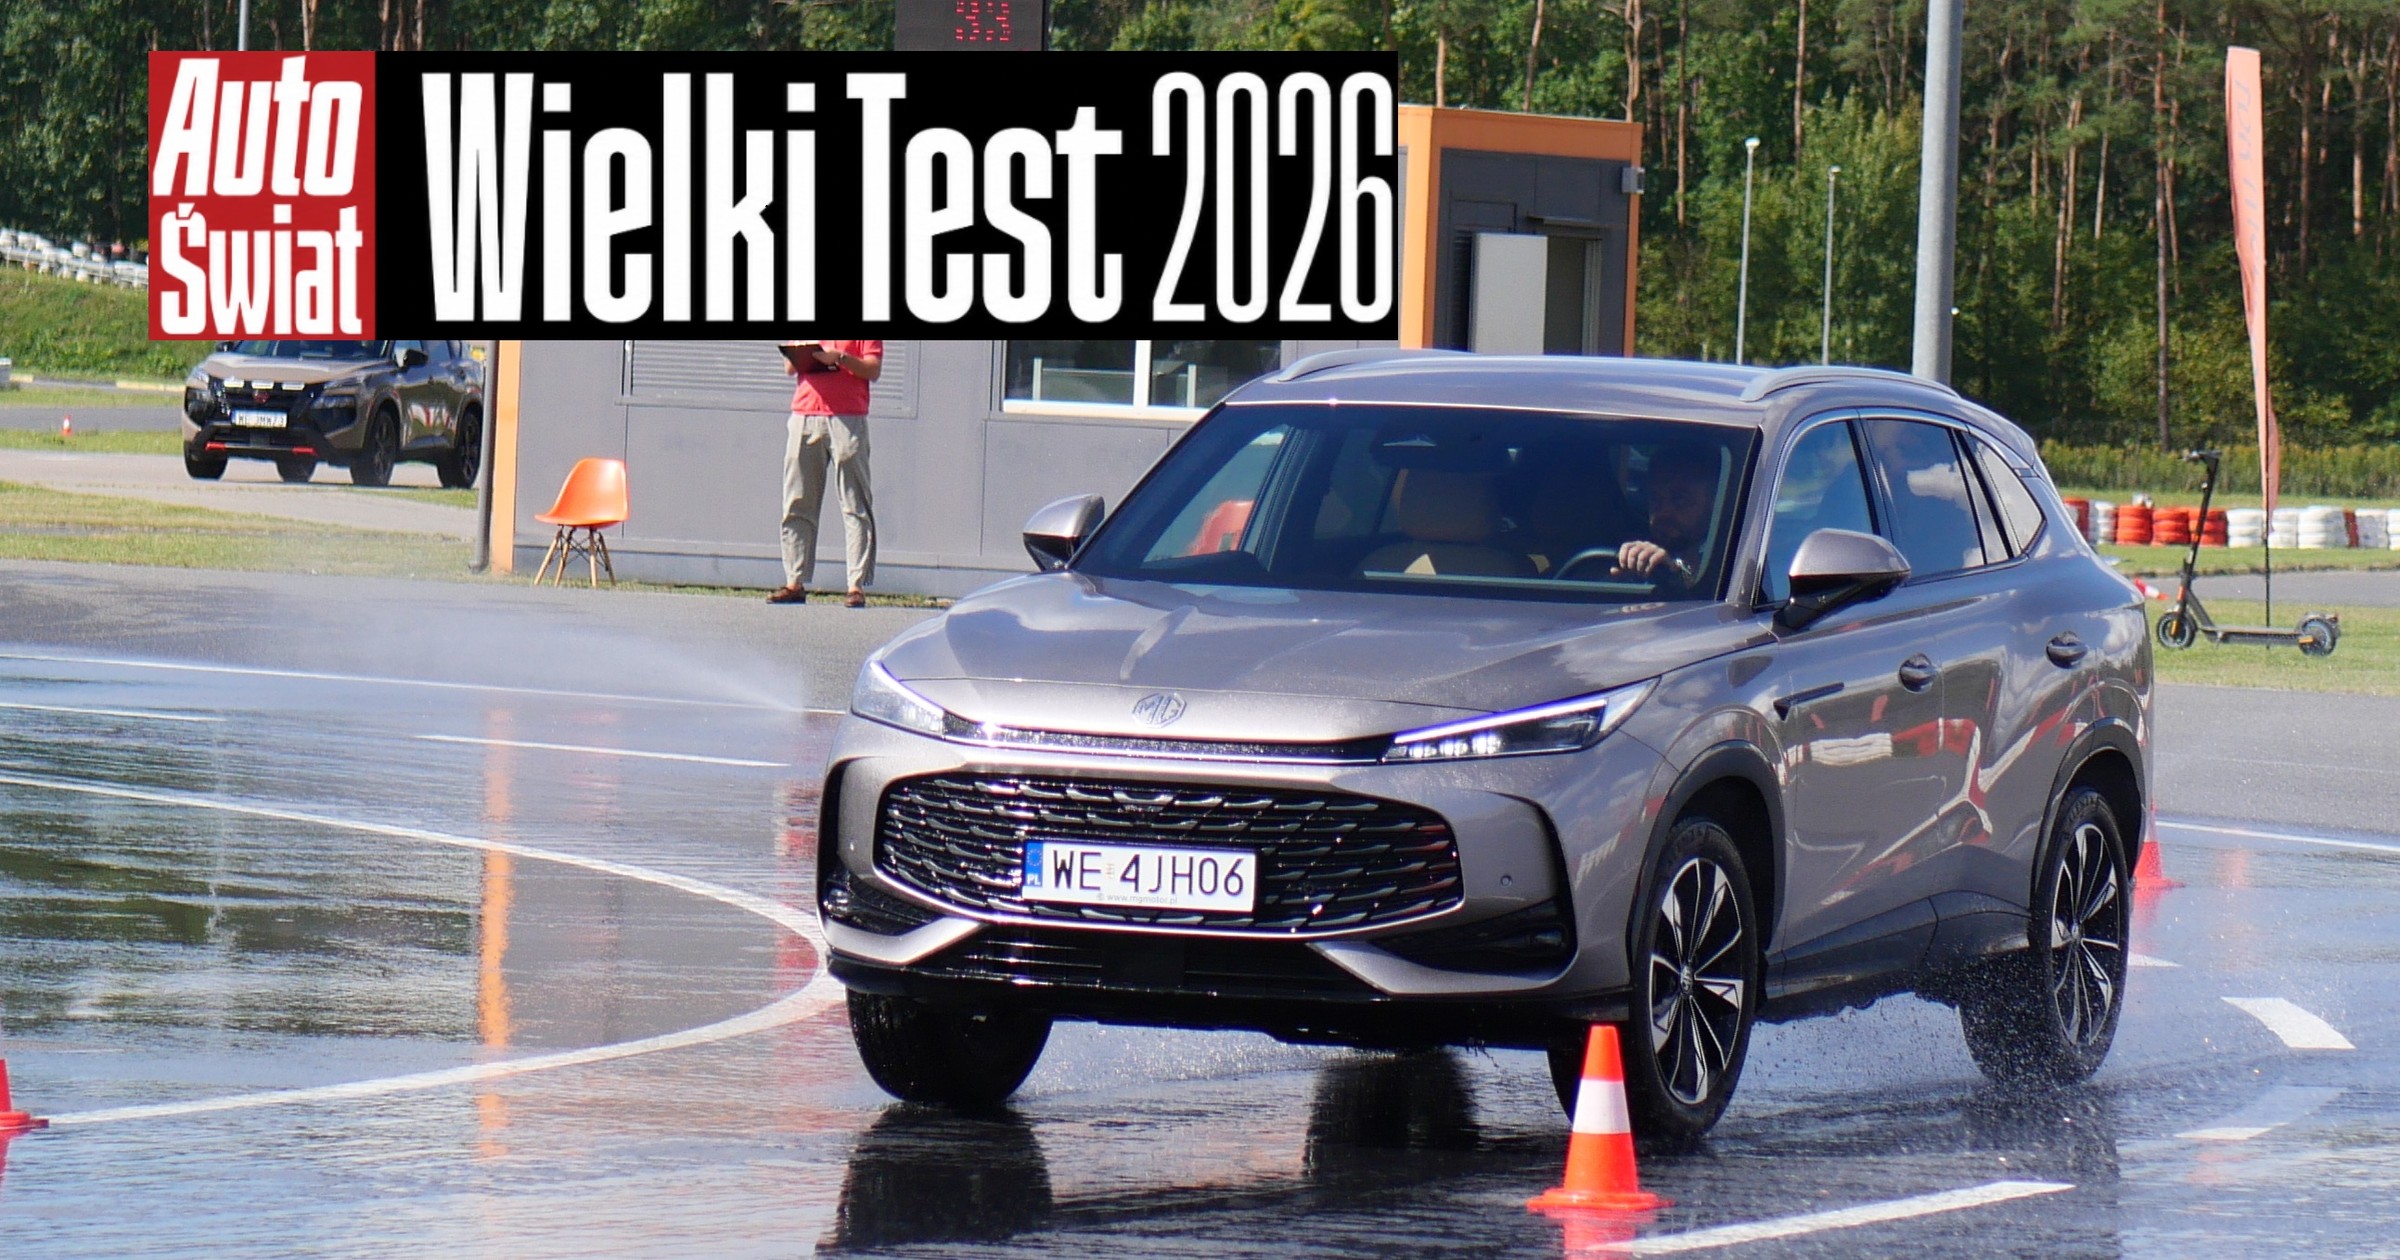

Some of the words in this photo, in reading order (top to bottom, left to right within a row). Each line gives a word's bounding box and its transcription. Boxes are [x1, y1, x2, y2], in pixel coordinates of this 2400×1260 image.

[1135, 694, 1184, 726] MG
[1026, 873, 1042, 887] PL
[1053, 849, 1103, 891] WE
[1119, 853, 1245, 897] 4JH06
